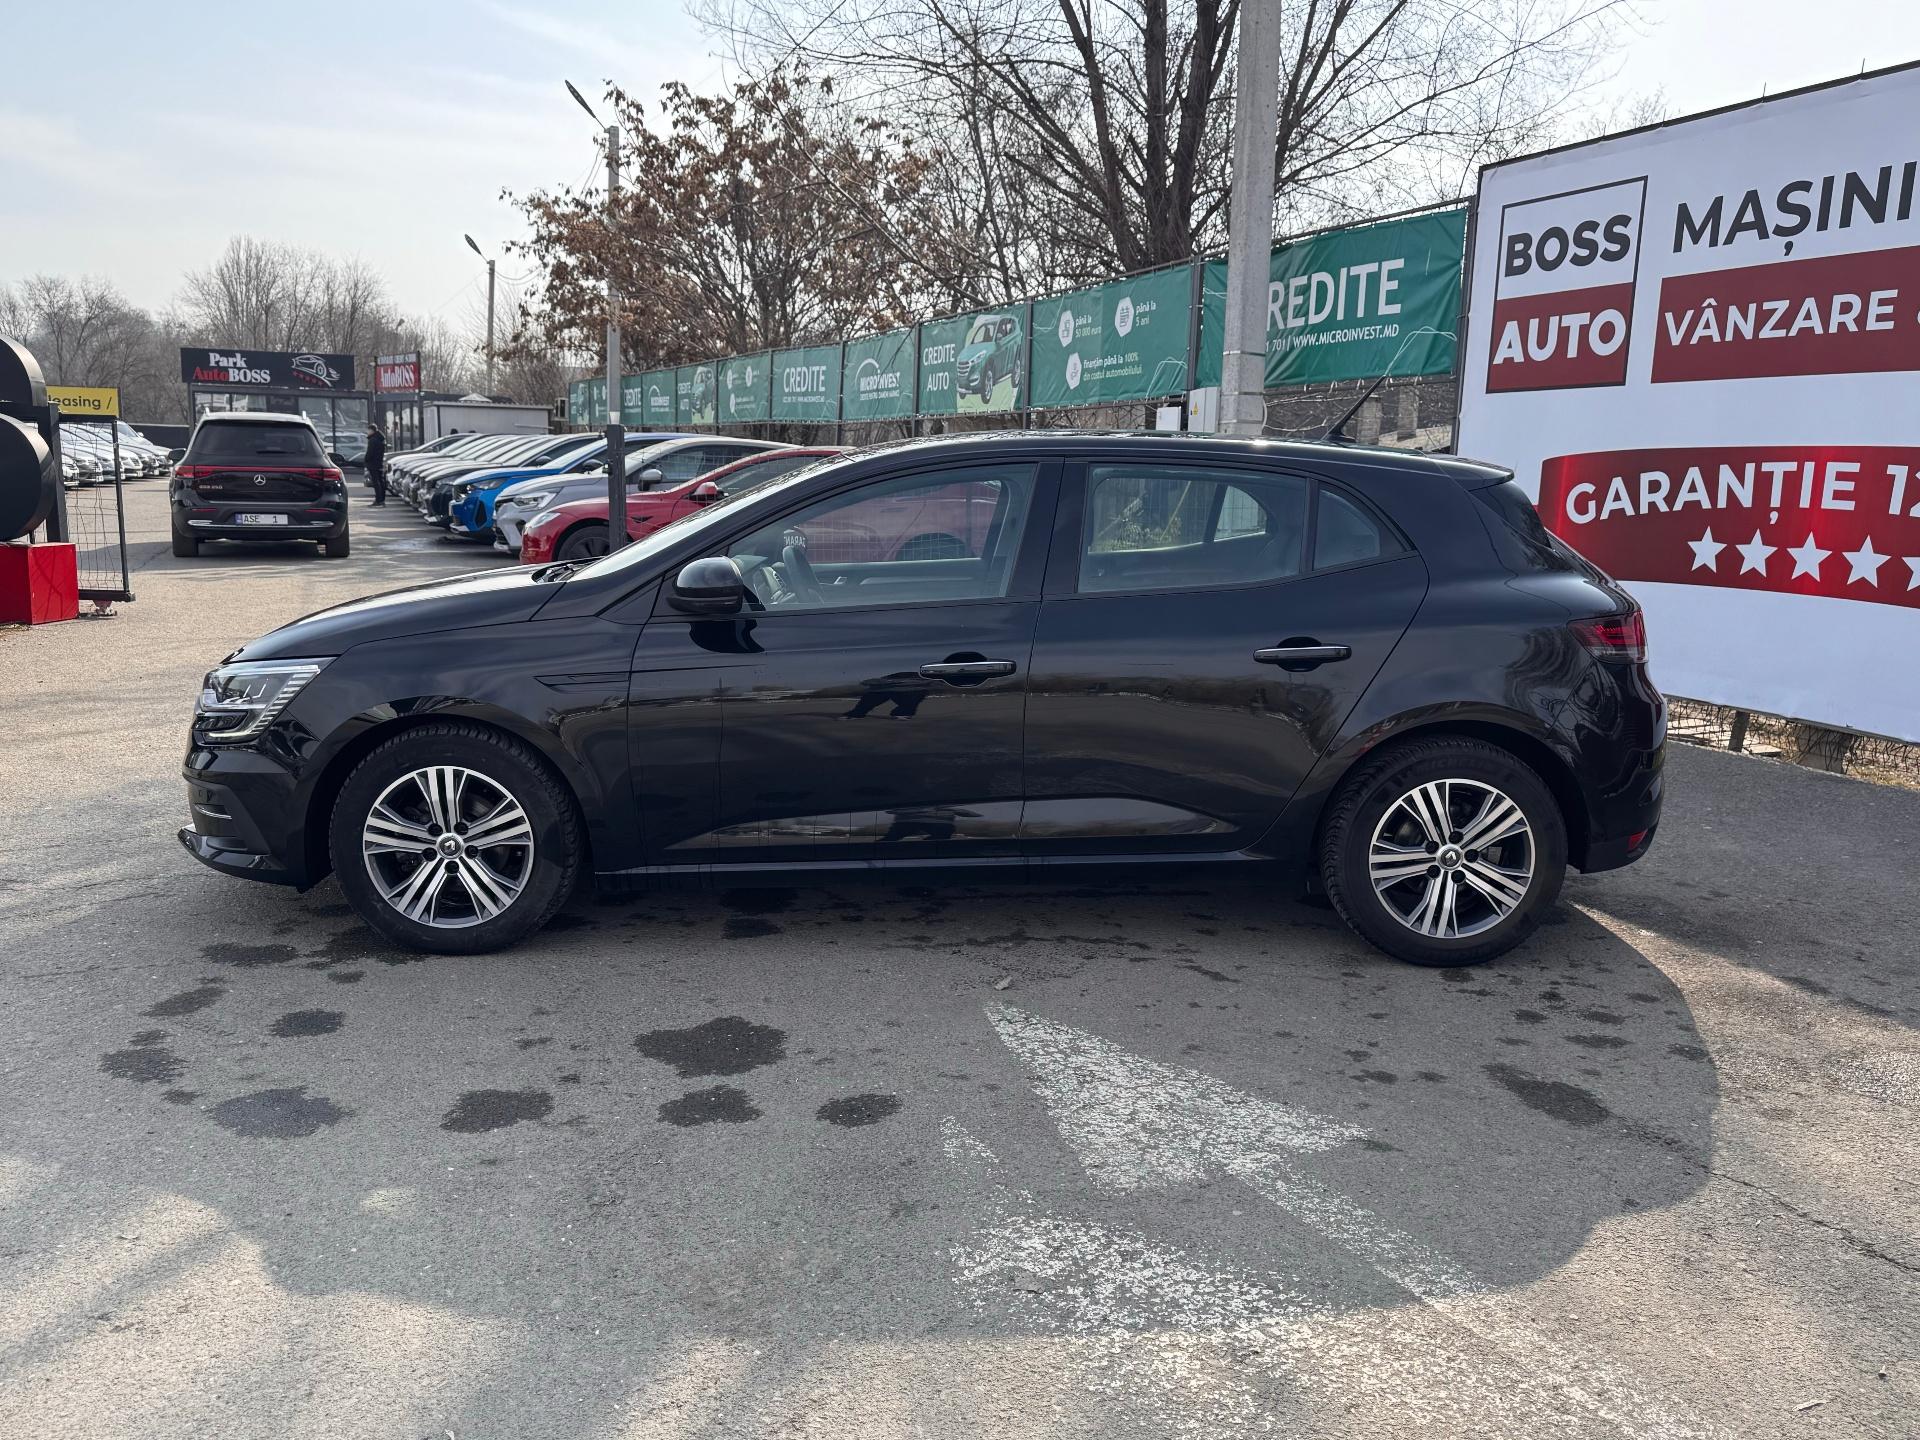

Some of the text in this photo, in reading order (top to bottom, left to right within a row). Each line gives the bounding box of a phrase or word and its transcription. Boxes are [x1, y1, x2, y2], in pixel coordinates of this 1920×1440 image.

[1672, 160, 1918, 256] MAȘINI
[1504, 214, 1632, 278] BOSS
[1267, 258, 1405, 331] REDITE
[1664, 289, 1899, 347] VÂNZARE
[1272, 337, 1286, 351] 701
[1293, 324, 1399, 348] WWW.MICROINVEST.MD
[1492, 308, 1627, 365] AUTO
[209, 352, 247, 368] Park
[923, 343, 956, 366] CREDITE
[193, 367, 271, 384] AutoBOSS
[783, 365, 827, 393] CREDITE
[926, 371, 950, 392] AUTO
[1565, 461, 1861, 524] GARANȚIE
[244, 515, 260, 523] ASE
